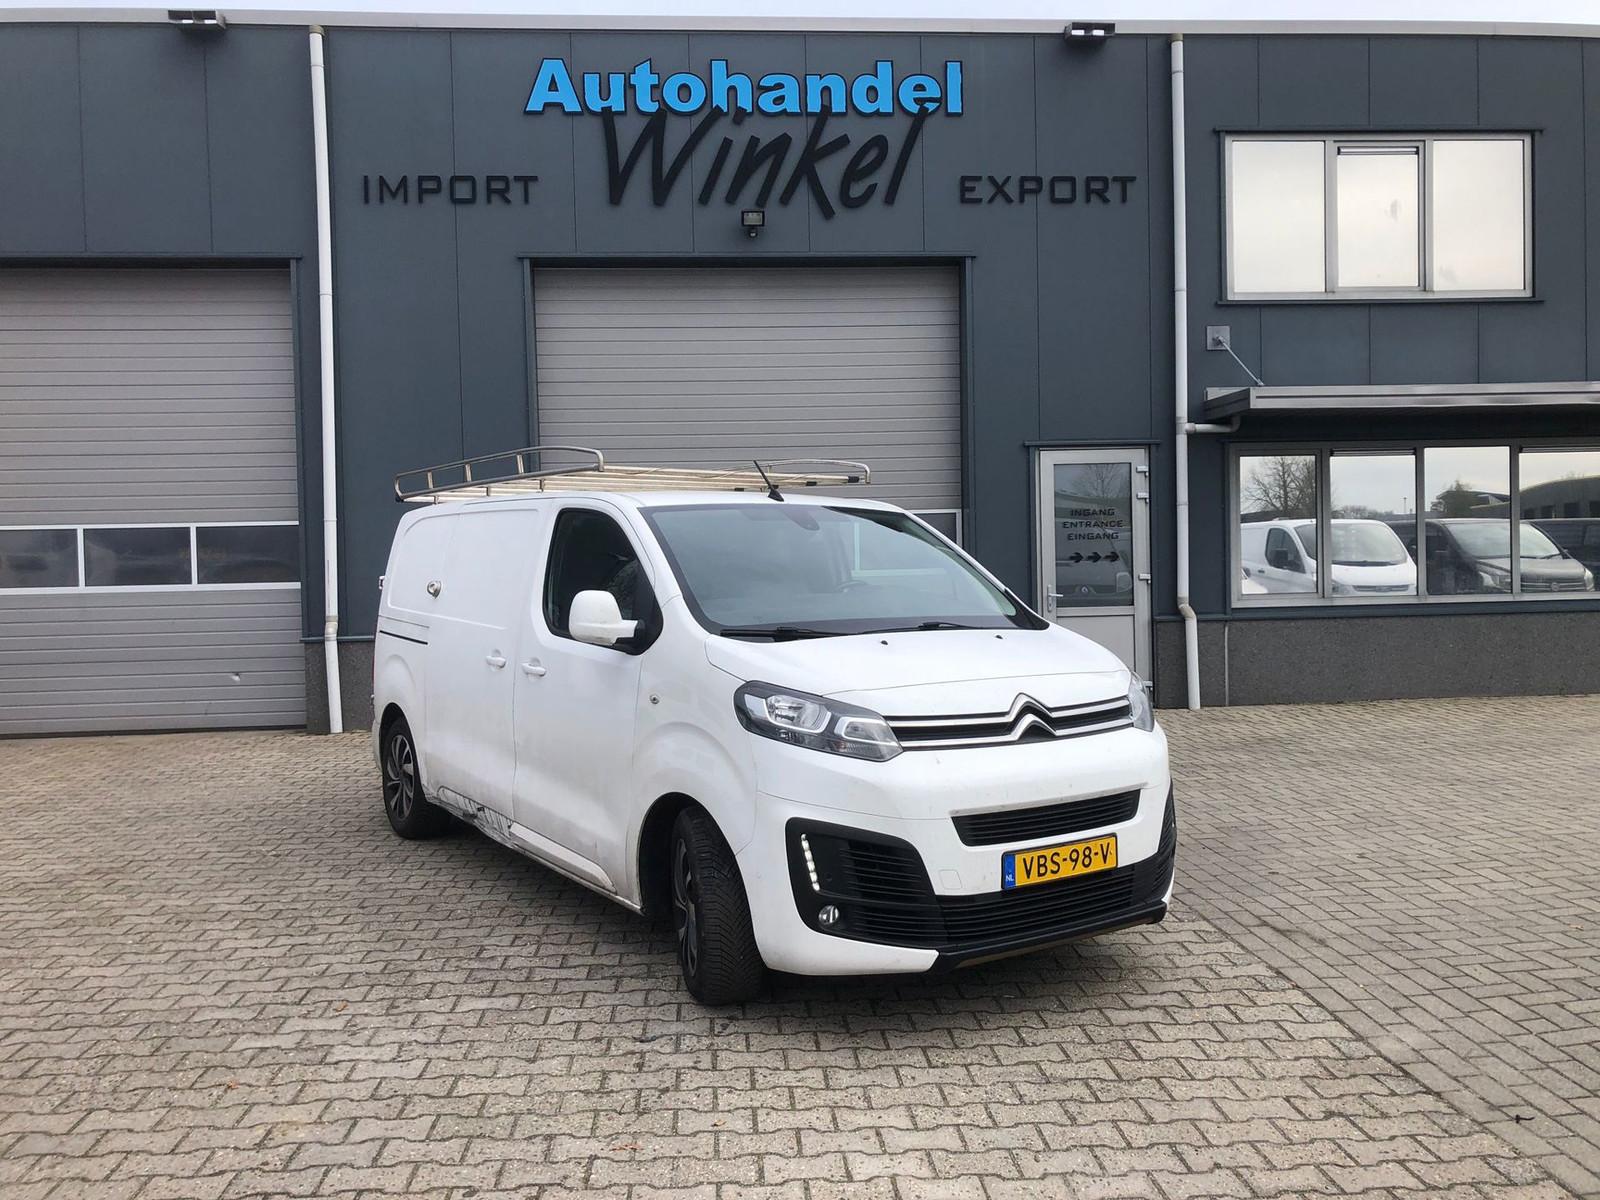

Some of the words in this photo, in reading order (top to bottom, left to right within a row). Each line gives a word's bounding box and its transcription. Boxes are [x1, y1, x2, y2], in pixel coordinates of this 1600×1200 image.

[524, 57, 963, 117] Autohandel
[601, 104, 929, 219] Winkel
[363, 175, 539, 205] IMPORT
[959, 175, 1137, 205] EXPORT
[1063, 519, 1124, 529] ENTRANCE
[1070, 508, 1115, 517] INGANG
[1067, 532, 1119, 541] EINGANG
[1022, 842, 1110, 879] VBS-98-V
[1005, 874, 1015, 882] NL
